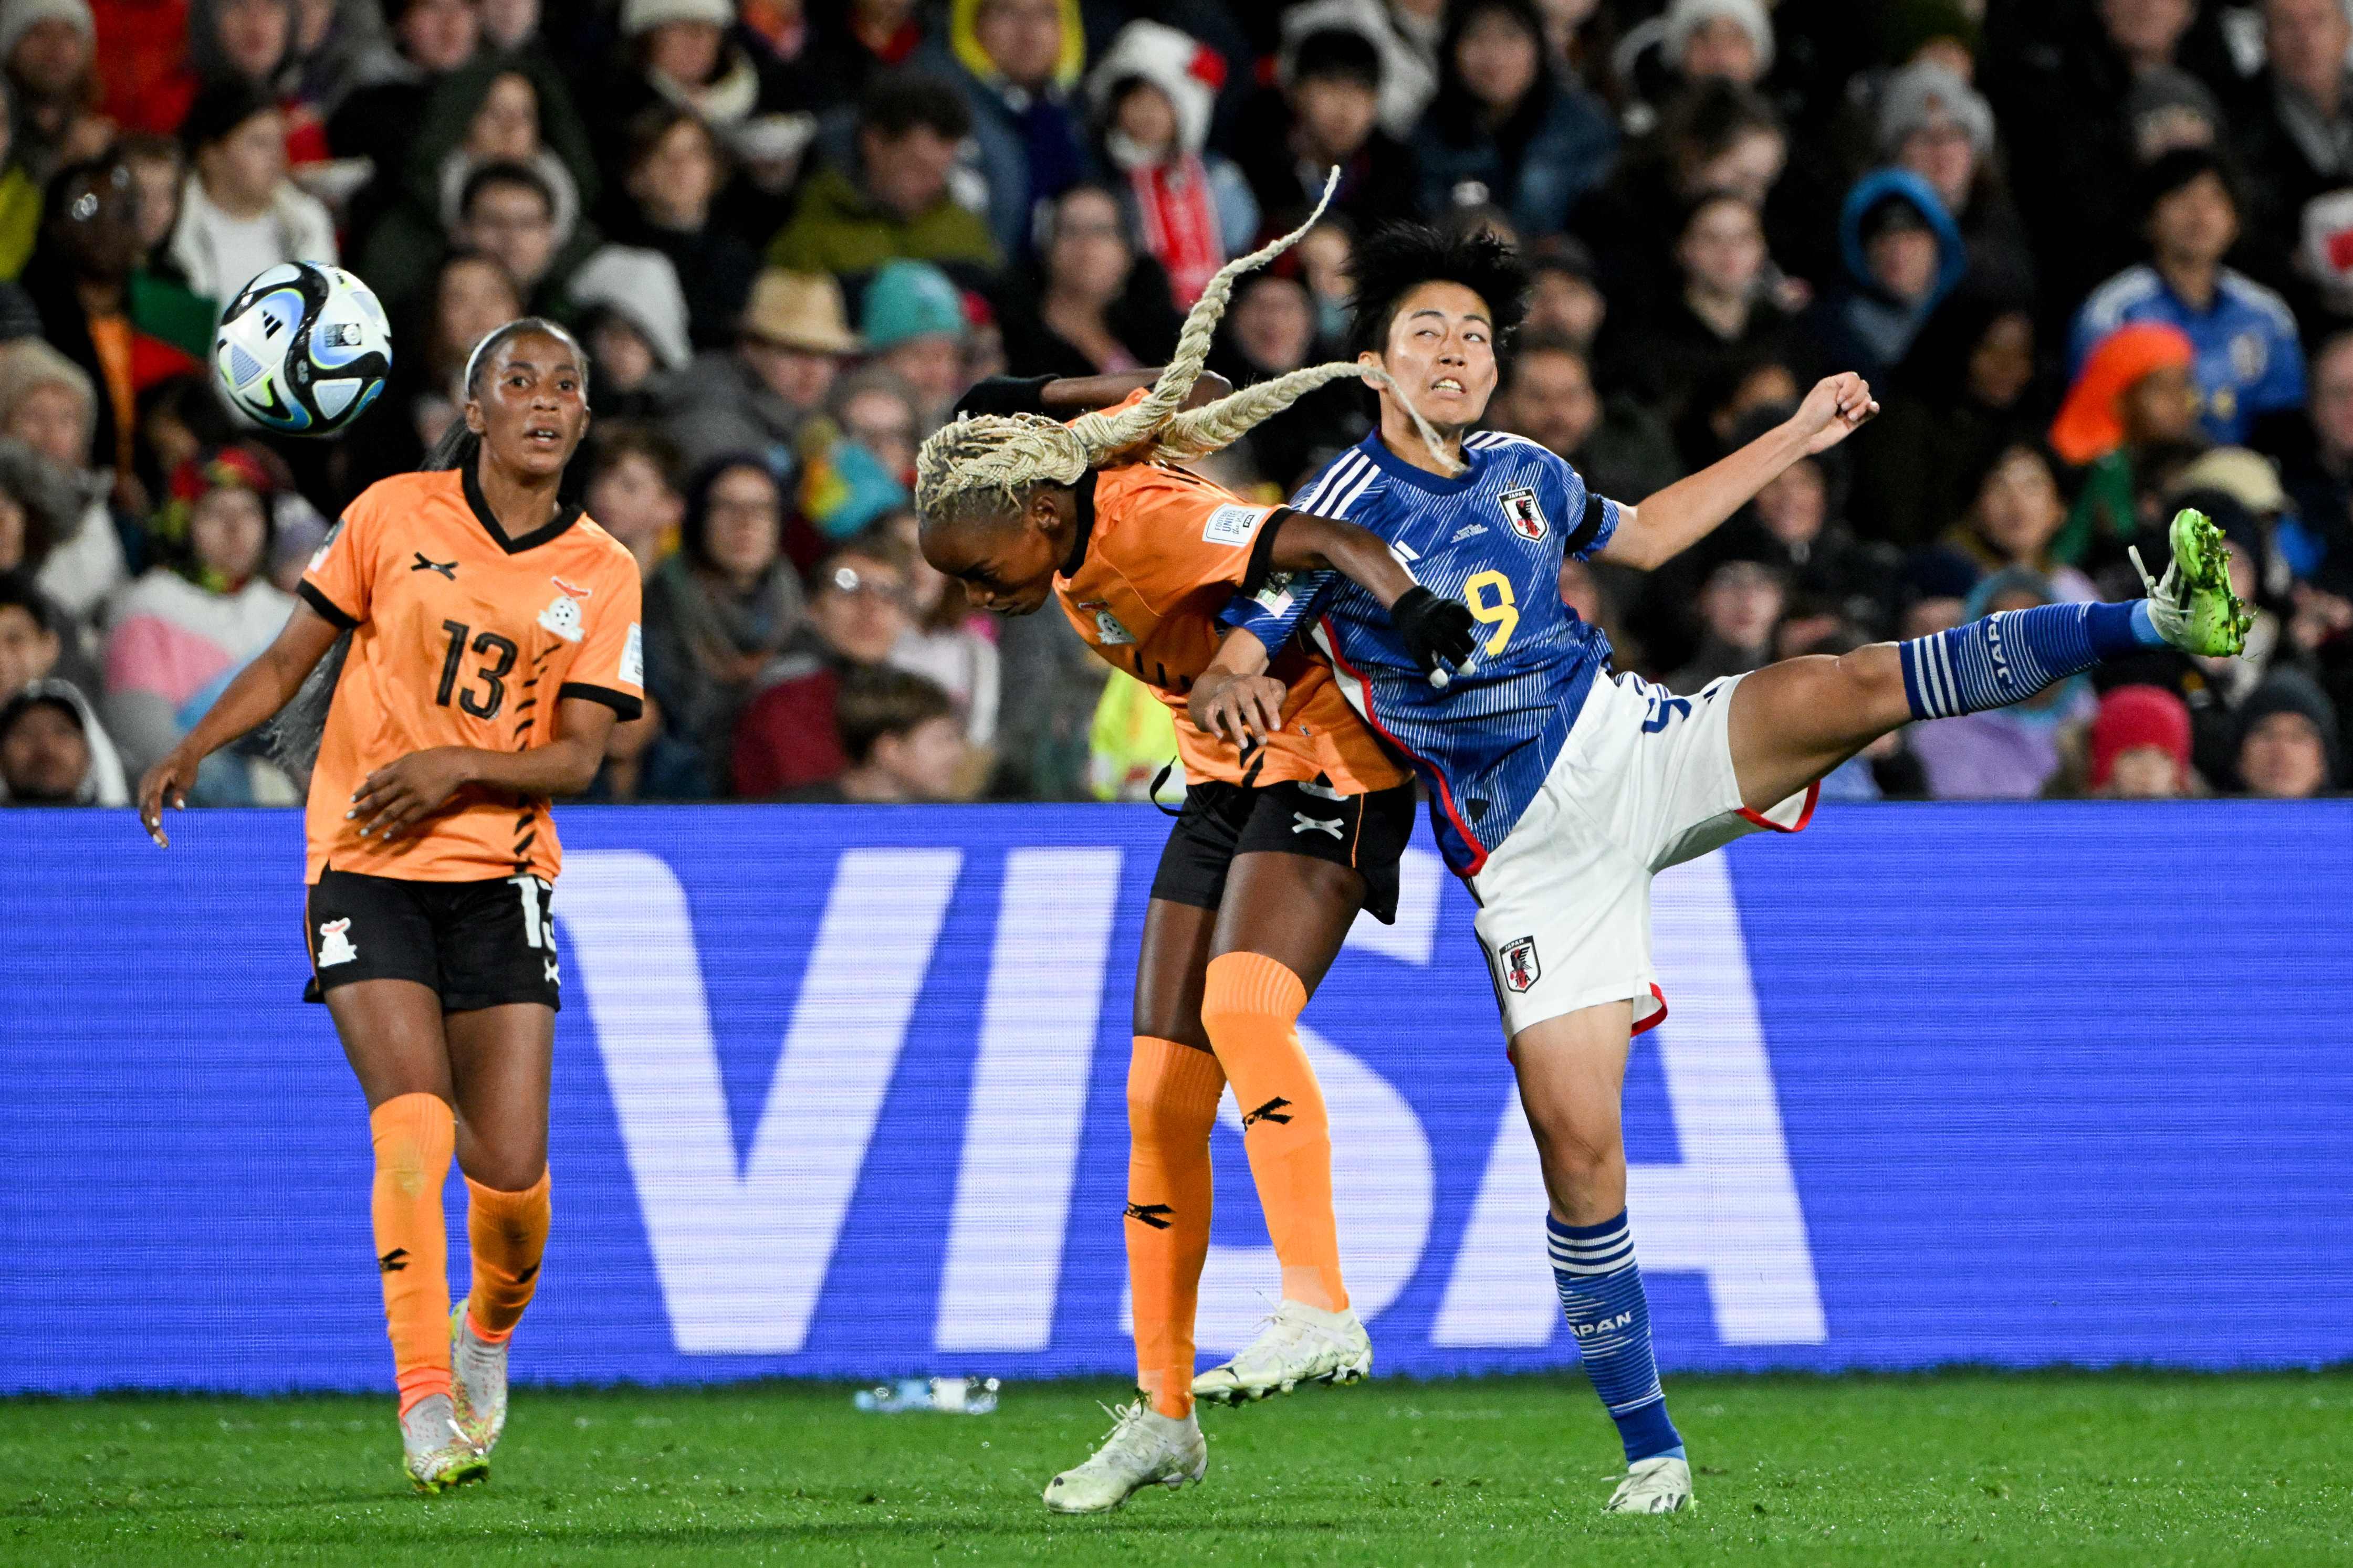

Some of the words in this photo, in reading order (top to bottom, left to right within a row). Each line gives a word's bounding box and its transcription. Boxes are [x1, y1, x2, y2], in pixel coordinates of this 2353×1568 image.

[1463, 570, 1519, 656] 9
[435, 619, 518, 720] 13
[1505, 939, 1524, 951] JAPAN
